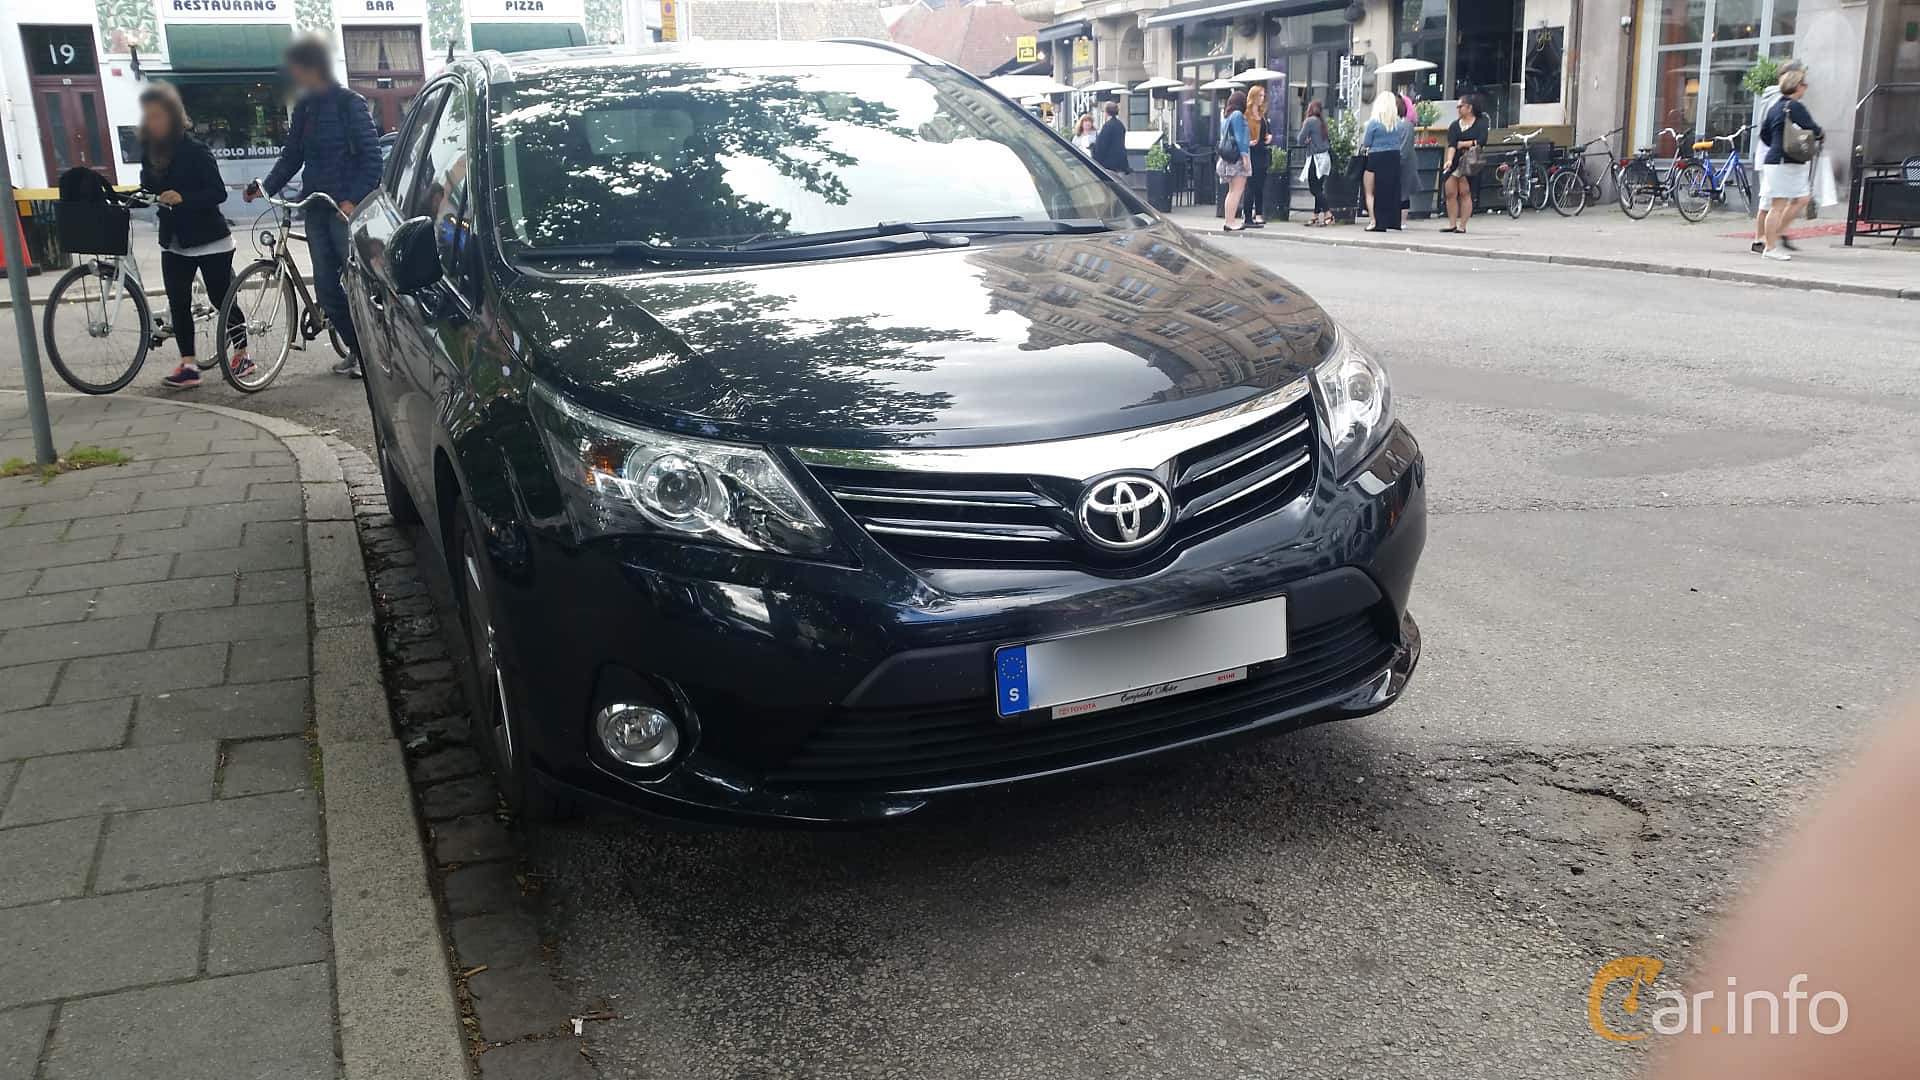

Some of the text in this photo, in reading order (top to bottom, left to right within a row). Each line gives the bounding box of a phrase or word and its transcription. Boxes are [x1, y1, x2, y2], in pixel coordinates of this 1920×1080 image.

[173, 0, 276, 10] RESTAURANG
[366, 1, 395, 11] BAR
[505, 1, 544, 11] PIZZA
[49, 44, 75, 65] 19
[211, 147, 245, 158] CCOLO
[1009, 687, 1020, 702] S
[1070, 703, 1097, 713] TOYOTA
